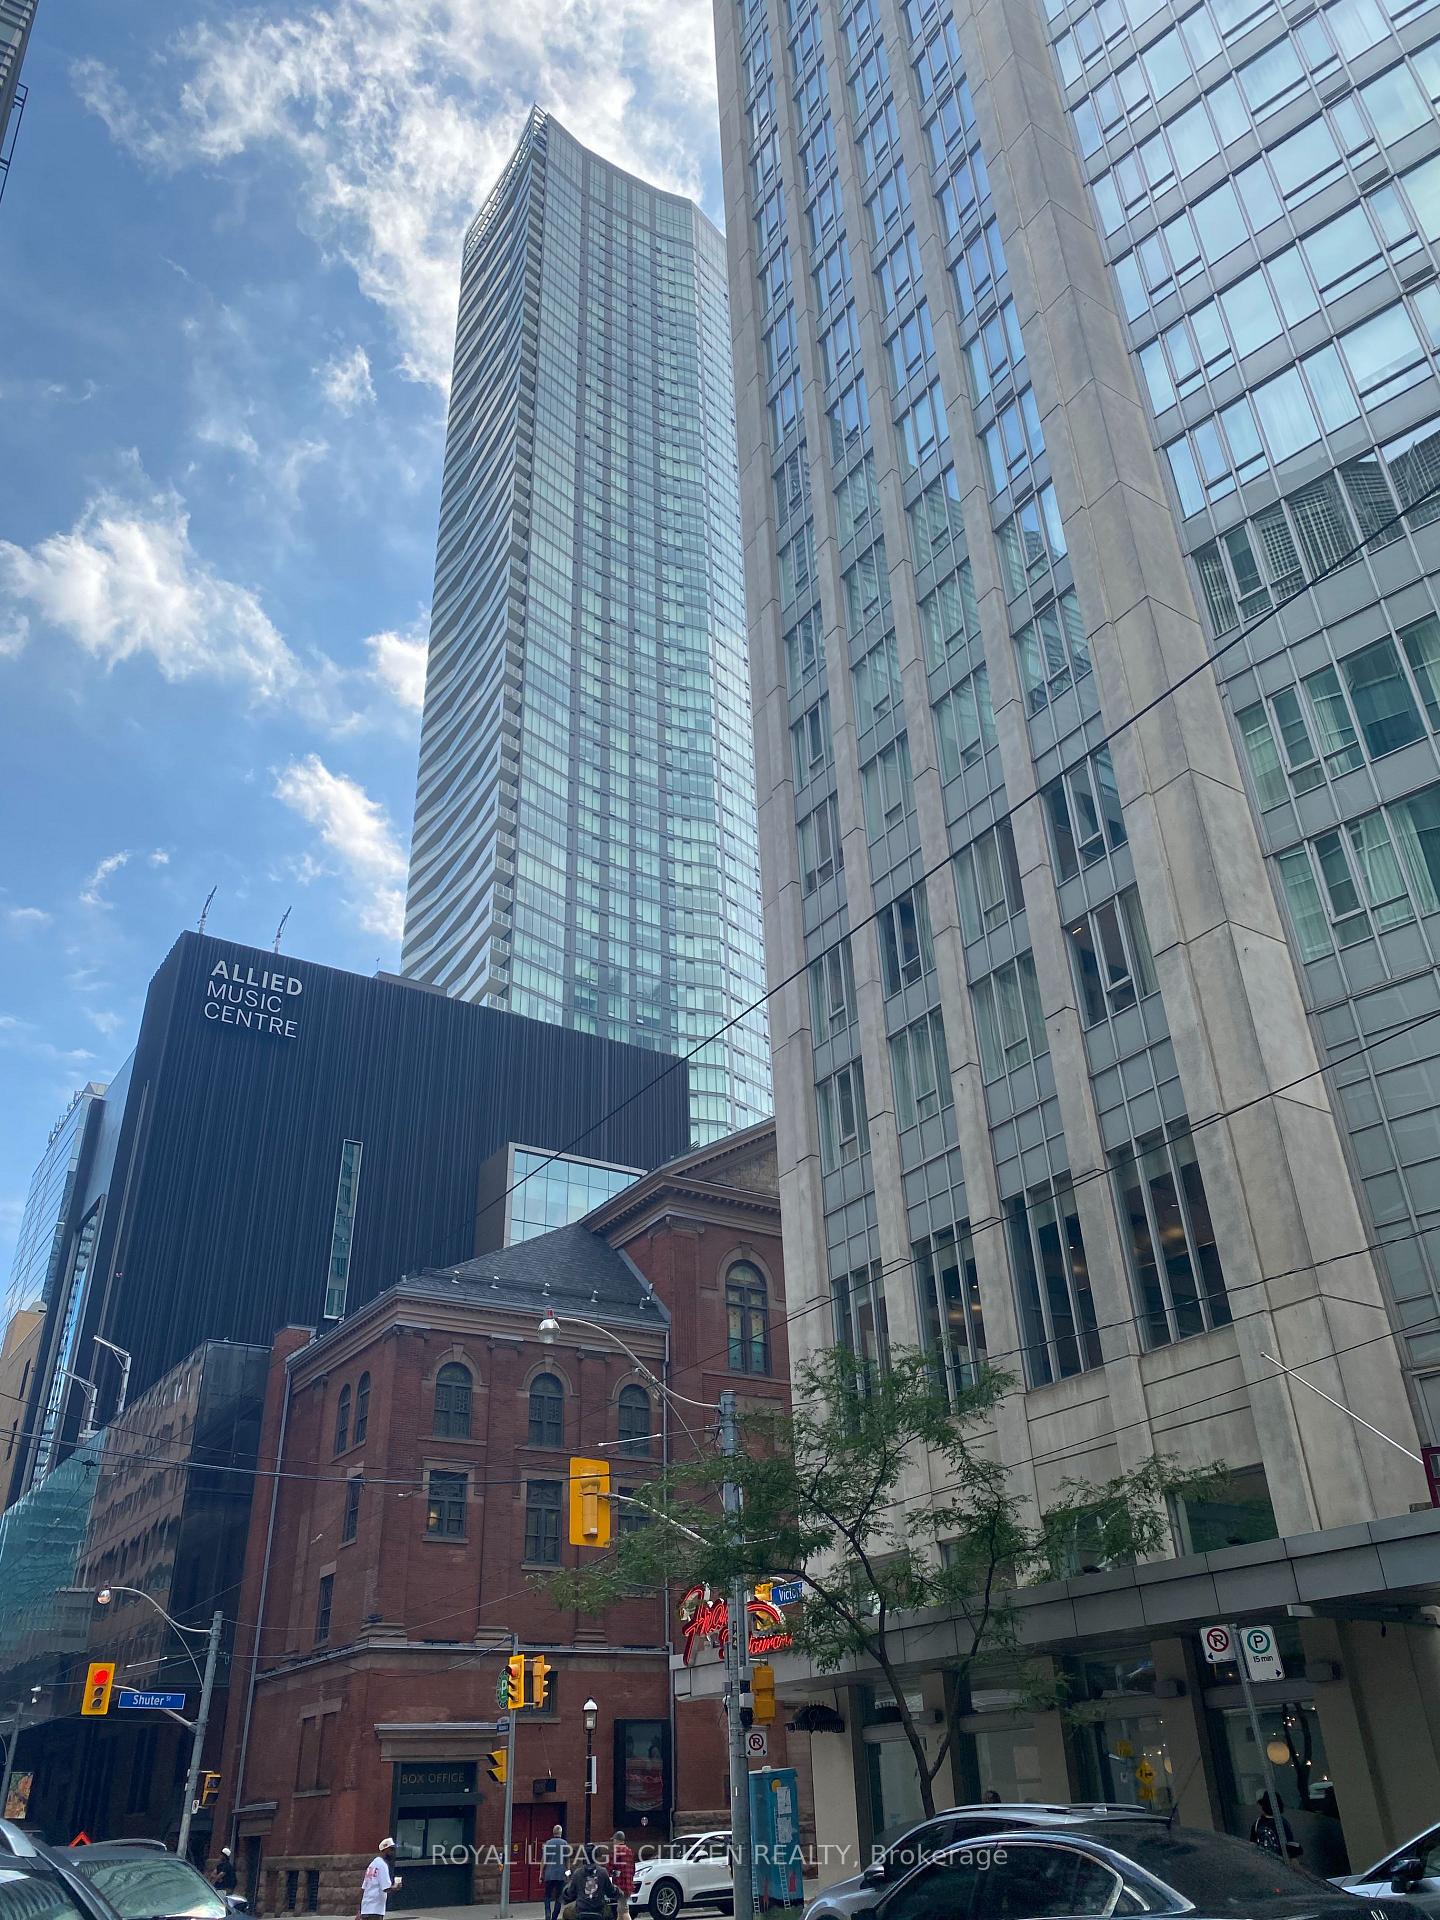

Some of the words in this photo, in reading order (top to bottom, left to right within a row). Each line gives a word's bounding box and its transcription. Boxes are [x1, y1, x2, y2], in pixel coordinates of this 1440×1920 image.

[210, 960, 303, 996] ALLIED
[207, 980, 282, 1013] MUSIC
[204, 1002, 298, 1038] CENTRE
[1253, 1655, 1261, 1663] 15
[1261, 1655, 1274, 1663] min
[132, 1694, 164, 1706] Shuter
[402, 1774, 424, 1784] BOX
[428, 1772, 465, 1783] OFFICE
